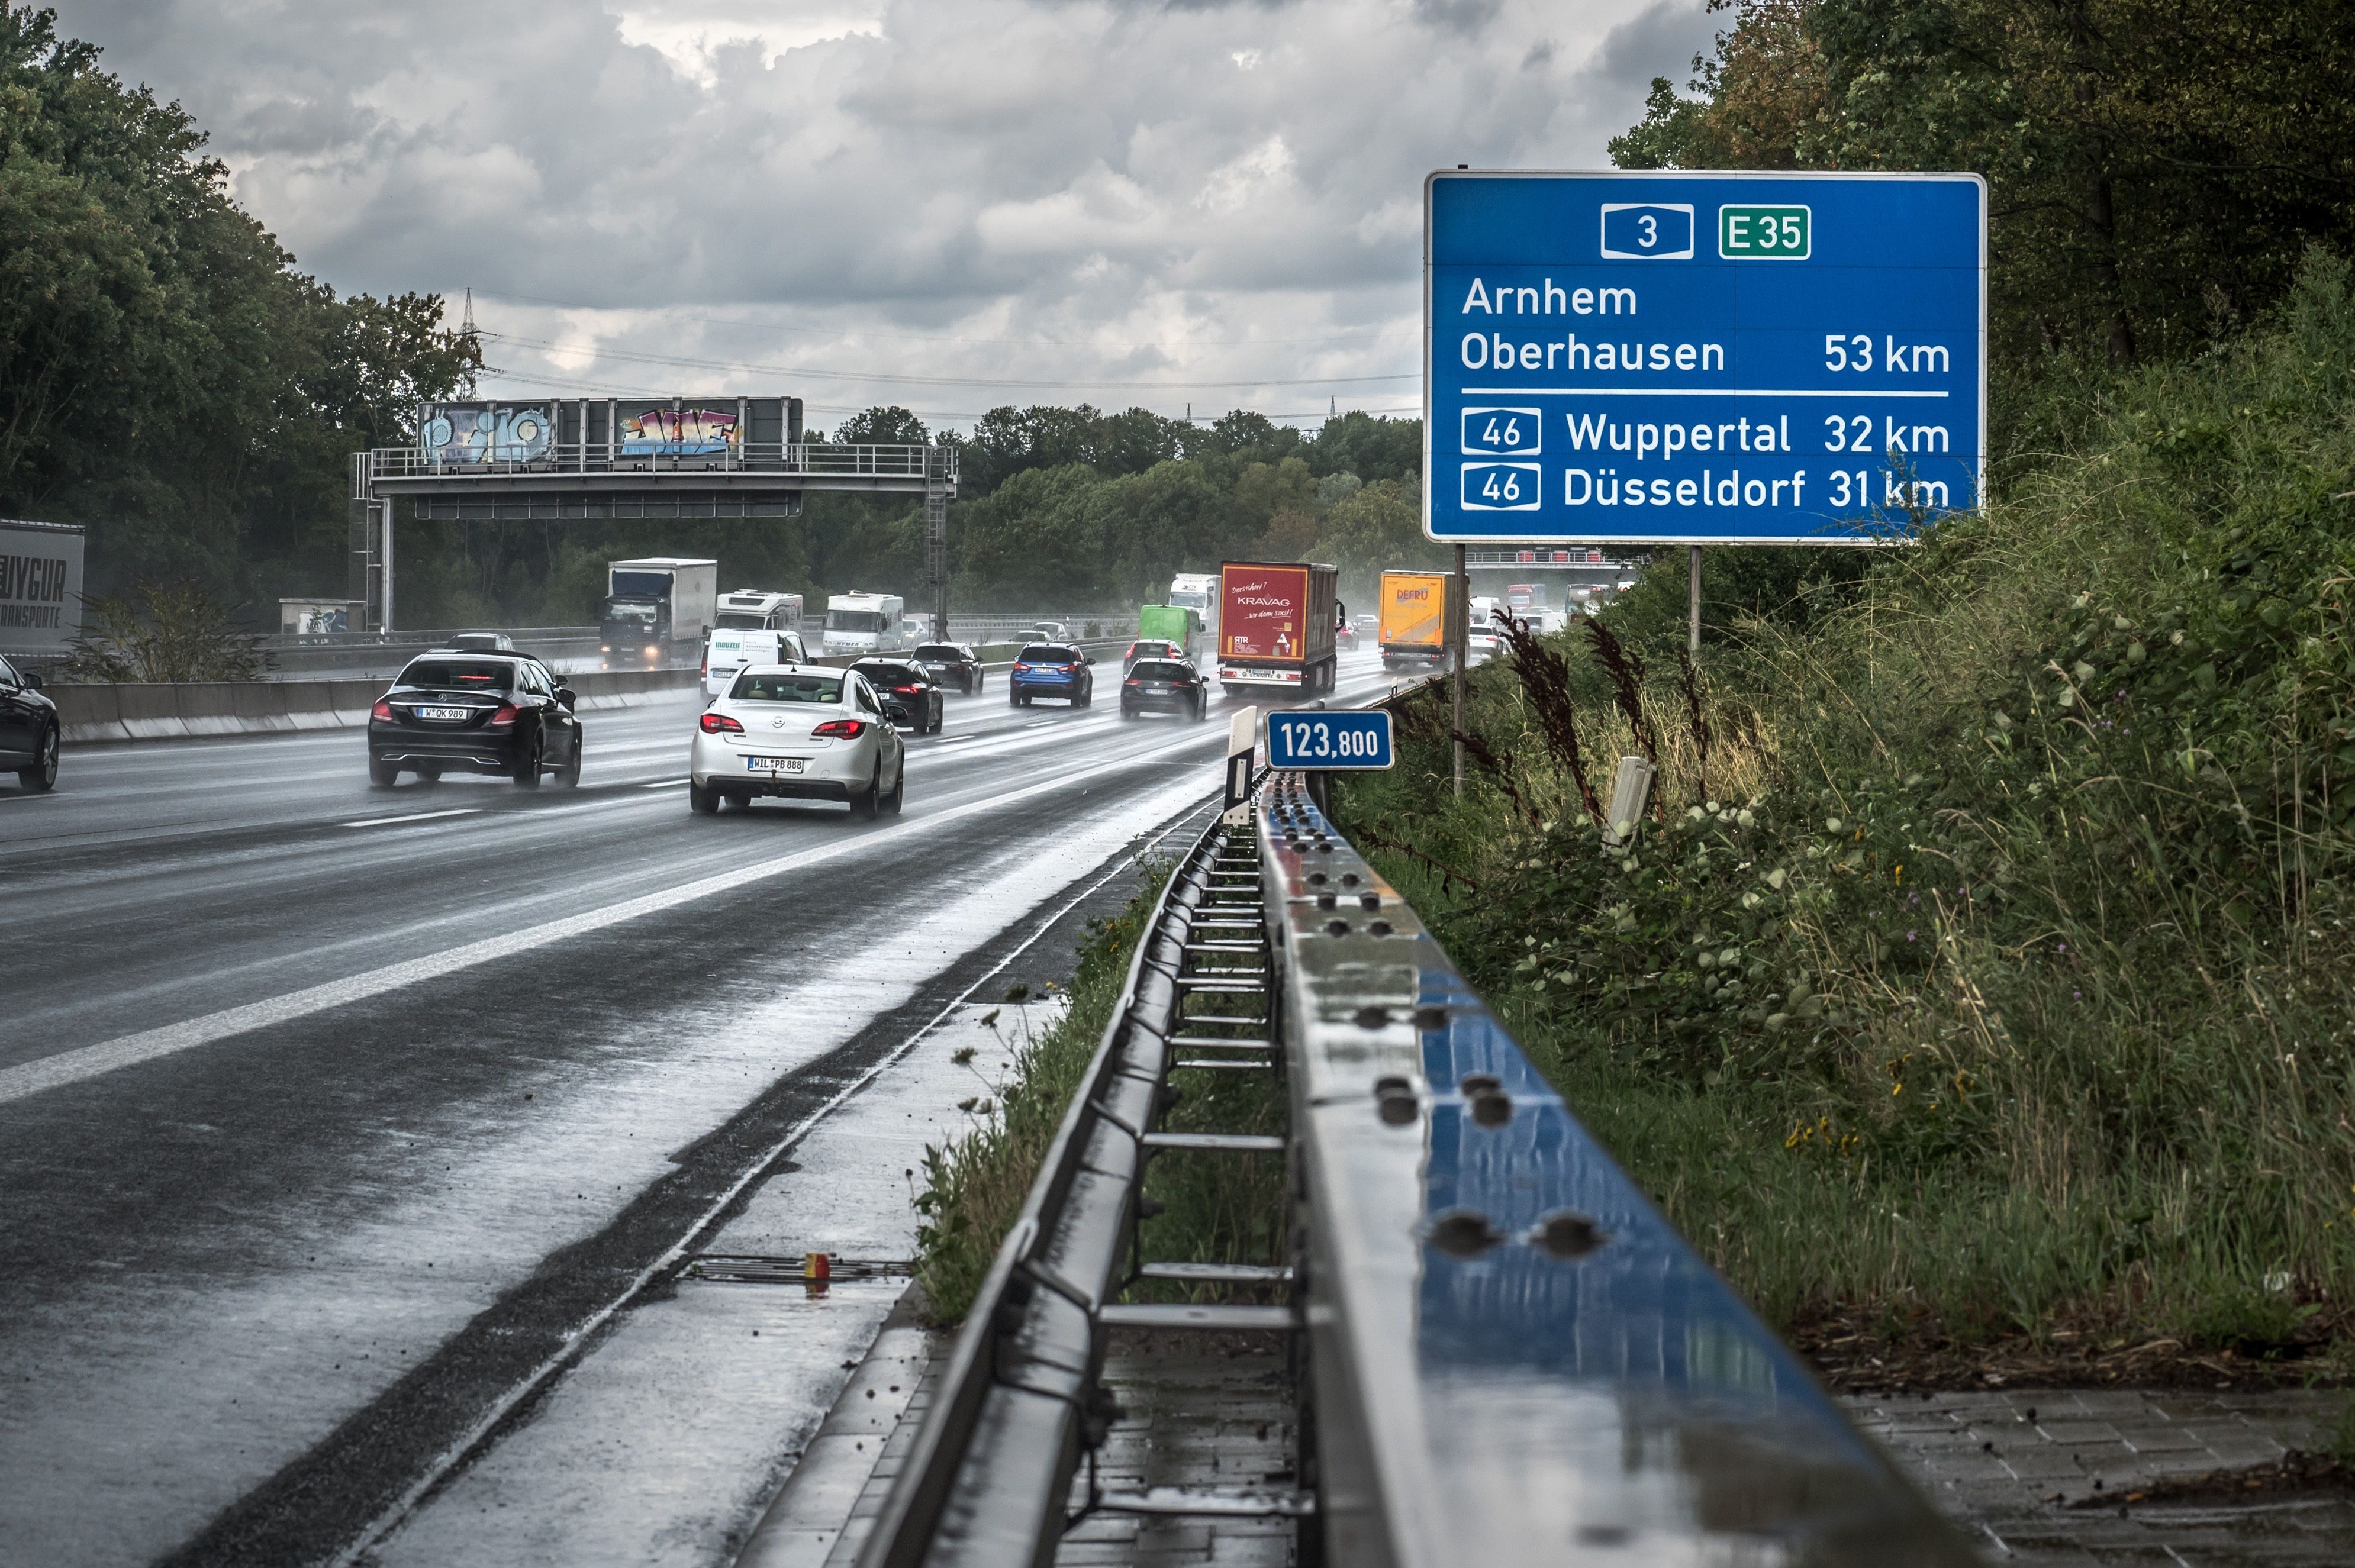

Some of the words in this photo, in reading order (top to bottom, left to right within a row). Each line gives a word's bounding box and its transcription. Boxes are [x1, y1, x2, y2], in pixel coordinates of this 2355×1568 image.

[1638, 215, 1657, 247] 3
[1729, 215, 1750, 248] E
[1758, 216, 1800, 249] 35
[1462, 278, 1636, 315] Arnhem
[1461, 333, 1723, 370] Oberhausen
[1825, 335, 1873, 372] 53
[1886, 335, 1949, 372] km
[1483, 418, 1520, 446] 46
[1566, 414, 1791, 460] Wuppertal
[1824, 415, 1872, 452] 32
[1886, 416, 1949, 453] km
[1482, 473, 1520, 501] 46
[1565, 469, 1805, 506] Düsseldorf
[1829, 470, 1873, 507] 31
[1886, 471, 1948, 508] km
[1238, 597, 1290, 606] KRAVAG
[1397, 589, 1429, 601] DEFRU
[0, 604, 62, 628] RANSPORTE
[426, 709, 431, 717] W
[448, 710, 464, 718] 989
[1281, 722, 1378, 759] 123,800
[755, 759, 769, 768] WIL
[775, 760, 785, 769] PB
[787, 760, 802, 769] 888
